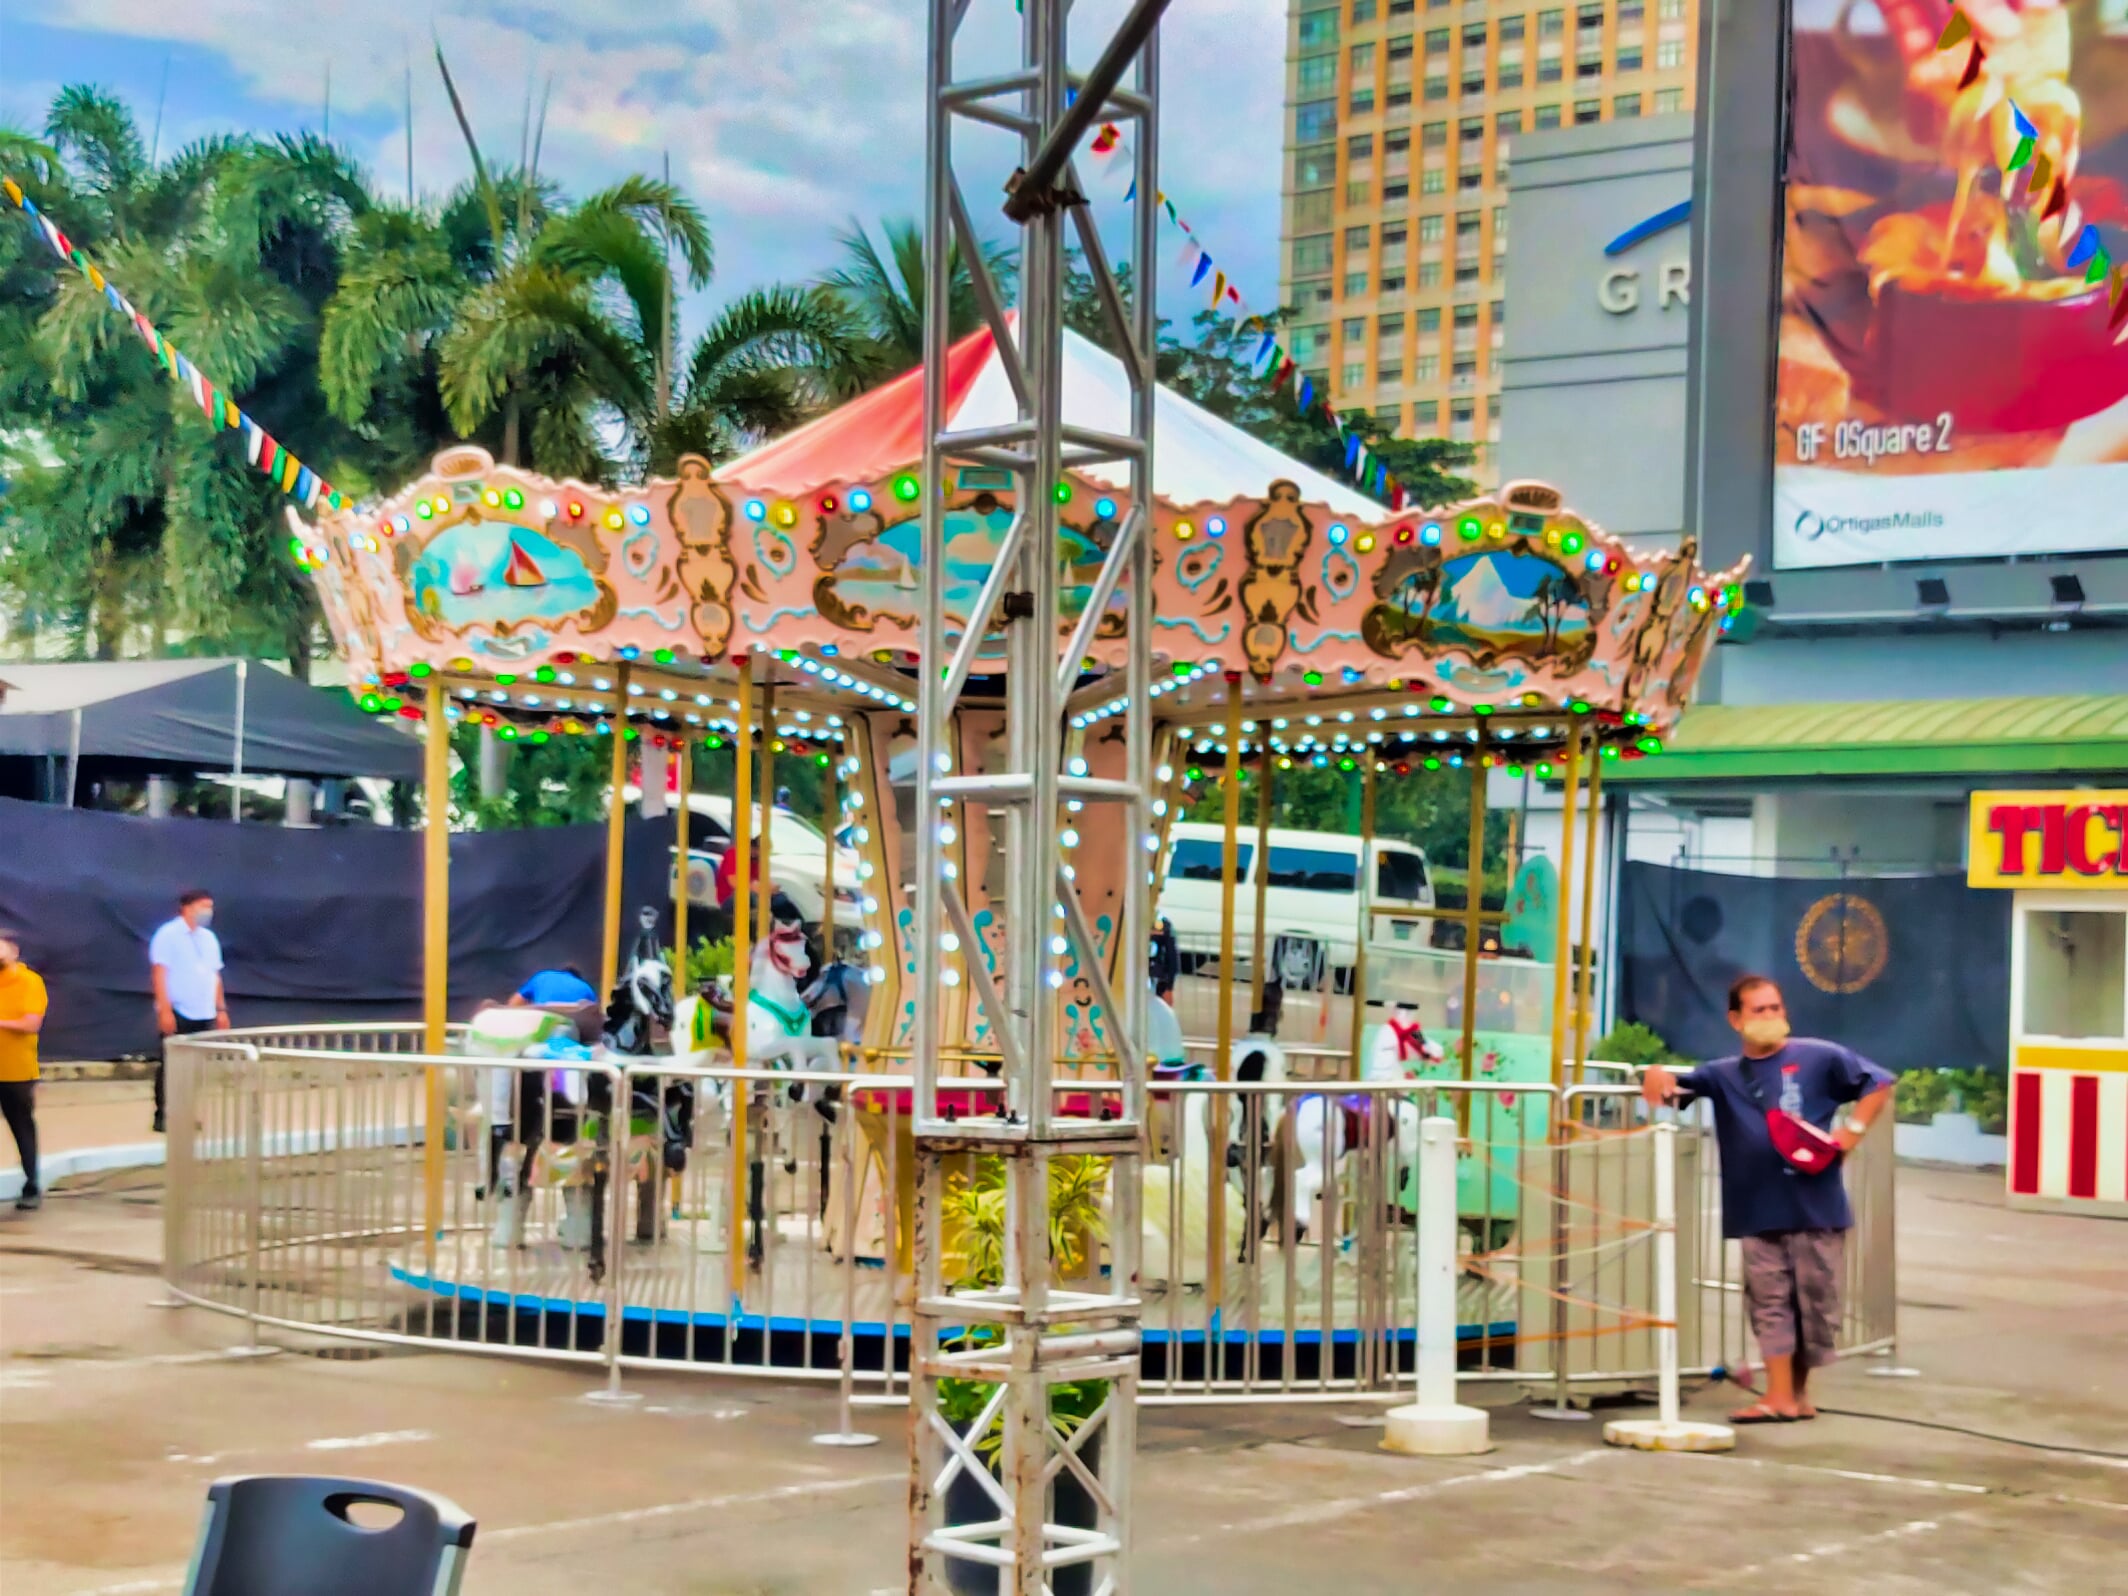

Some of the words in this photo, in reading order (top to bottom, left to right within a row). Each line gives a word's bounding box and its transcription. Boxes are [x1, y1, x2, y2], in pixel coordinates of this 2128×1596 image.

[1797, 422, 1825, 461] GF
[1936, 411, 1954, 451] 2
[1826, 511, 1944, 535] OrtigasMalls
[1988, 804, 2128, 876] TIC
